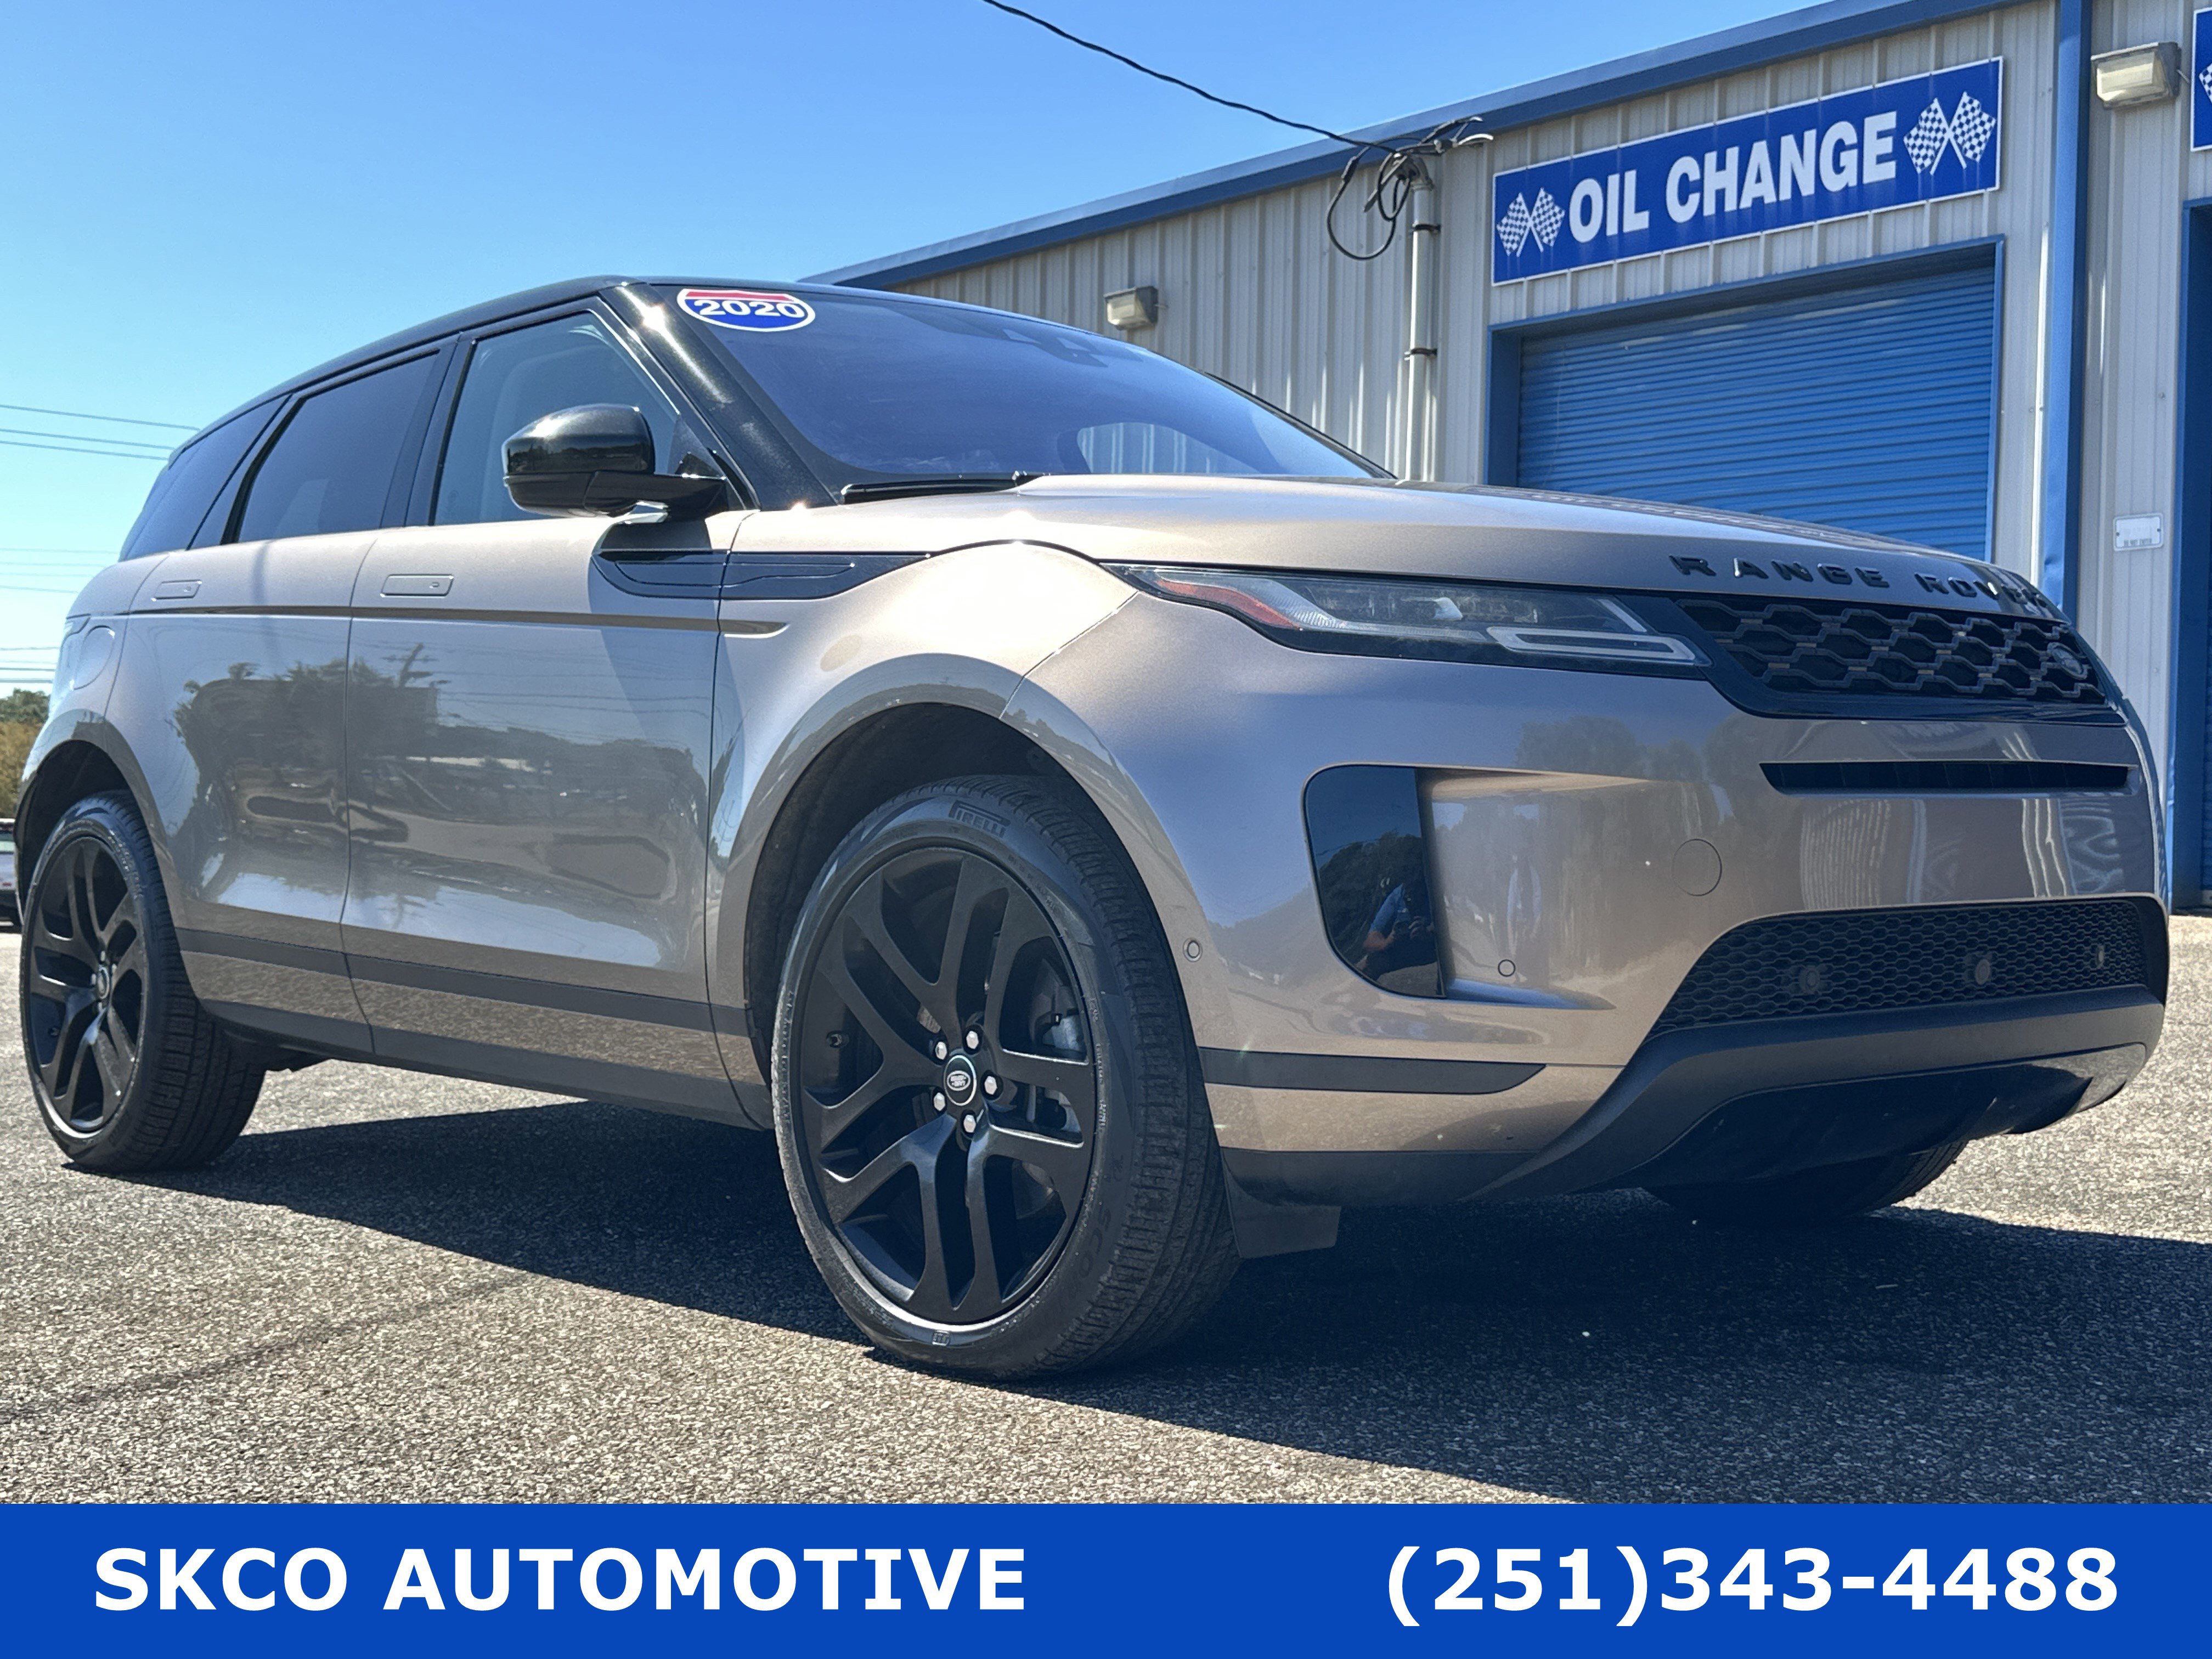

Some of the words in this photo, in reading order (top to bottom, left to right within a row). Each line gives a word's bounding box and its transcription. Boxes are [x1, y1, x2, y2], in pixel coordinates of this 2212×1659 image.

[1569, 170, 1649, 243] OIL
[1665, 111, 1897, 223] CHANGE
[693, 300, 805, 318] 2020
[1668, 554, 1891, 589] RANGE
[948, 799, 1012, 838] PIRELLI
